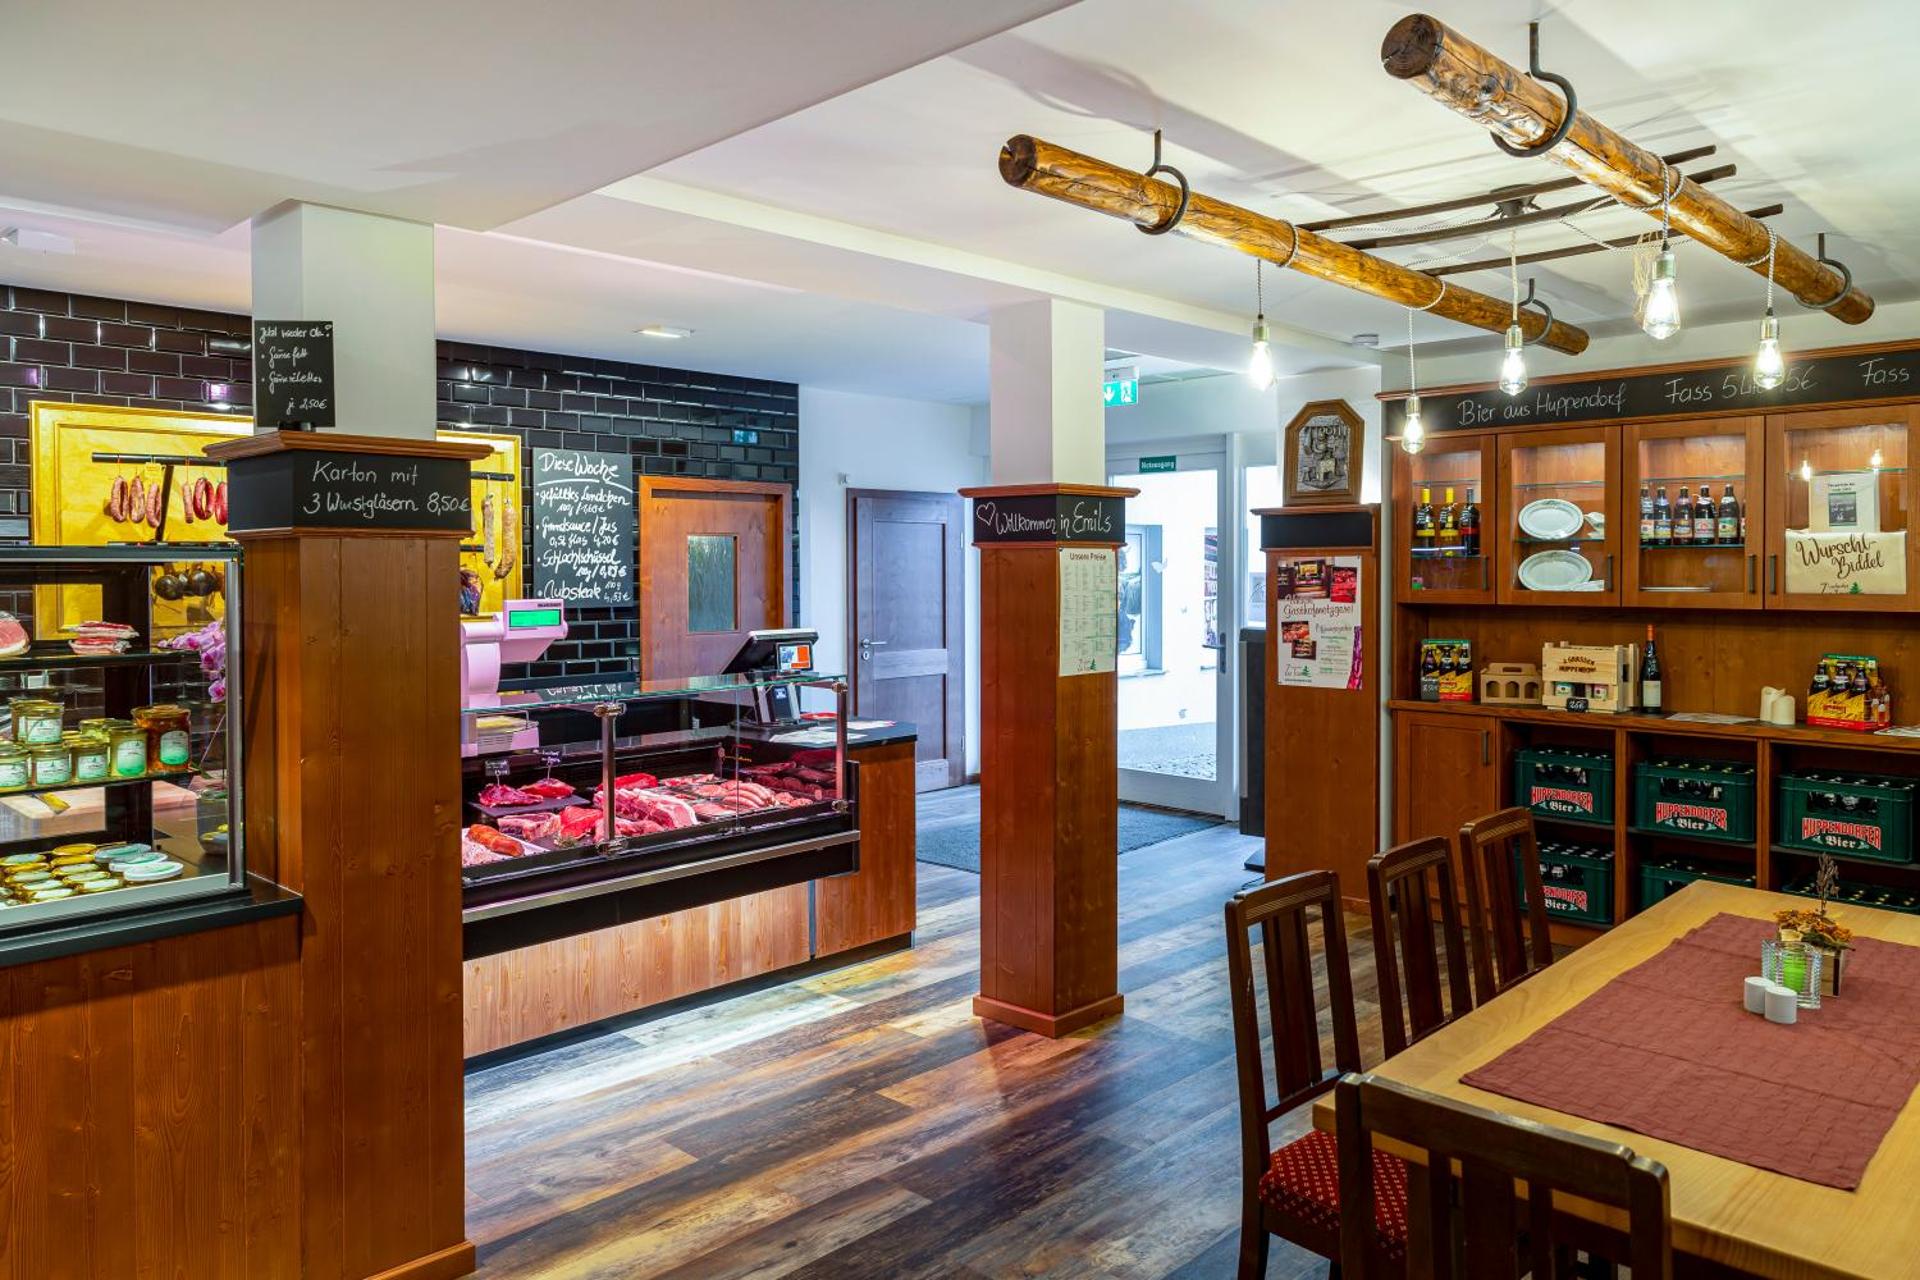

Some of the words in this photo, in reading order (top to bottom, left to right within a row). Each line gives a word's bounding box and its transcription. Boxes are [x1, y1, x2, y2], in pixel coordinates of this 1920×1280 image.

[1859, 357, 1910, 386] Fass
[1664, 377, 1713, 404] Fass
[1721, 374, 1738, 399] 5
[1457, 400, 1496, 426] Bier
[1503, 403, 1531, 420] aus
[1536, 382, 1627, 416] Huppendorf
[312, 460, 378, 484] Karton
[391, 464, 420, 486] mit
[538, 452, 575, 473] Diese
[574, 453, 620, 482] Woche
[303, 493, 321, 514] 3
[327, 492, 420, 519] Wurstgläsern
[427, 491, 471, 516] 8,50€
[996, 511, 1057, 535] Willkommen
[1060, 514, 1072, 539] in
[1073, 500, 1113, 534] Emils
[1831, 551, 1884, 579] Biddel
[1531, 785, 1594, 814] HUPPENDORFER
[1550, 801, 1575, 813] Bier
[1655, 801, 1727, 832] HUPPENDORFER
[1676, 817, 1705, 830] Bier
[1801, 817, 1882, 851] HUPPENDORFER
[1824, 835, 1856, 849] Bier
[1544, 899, 1569, 911] Bier
